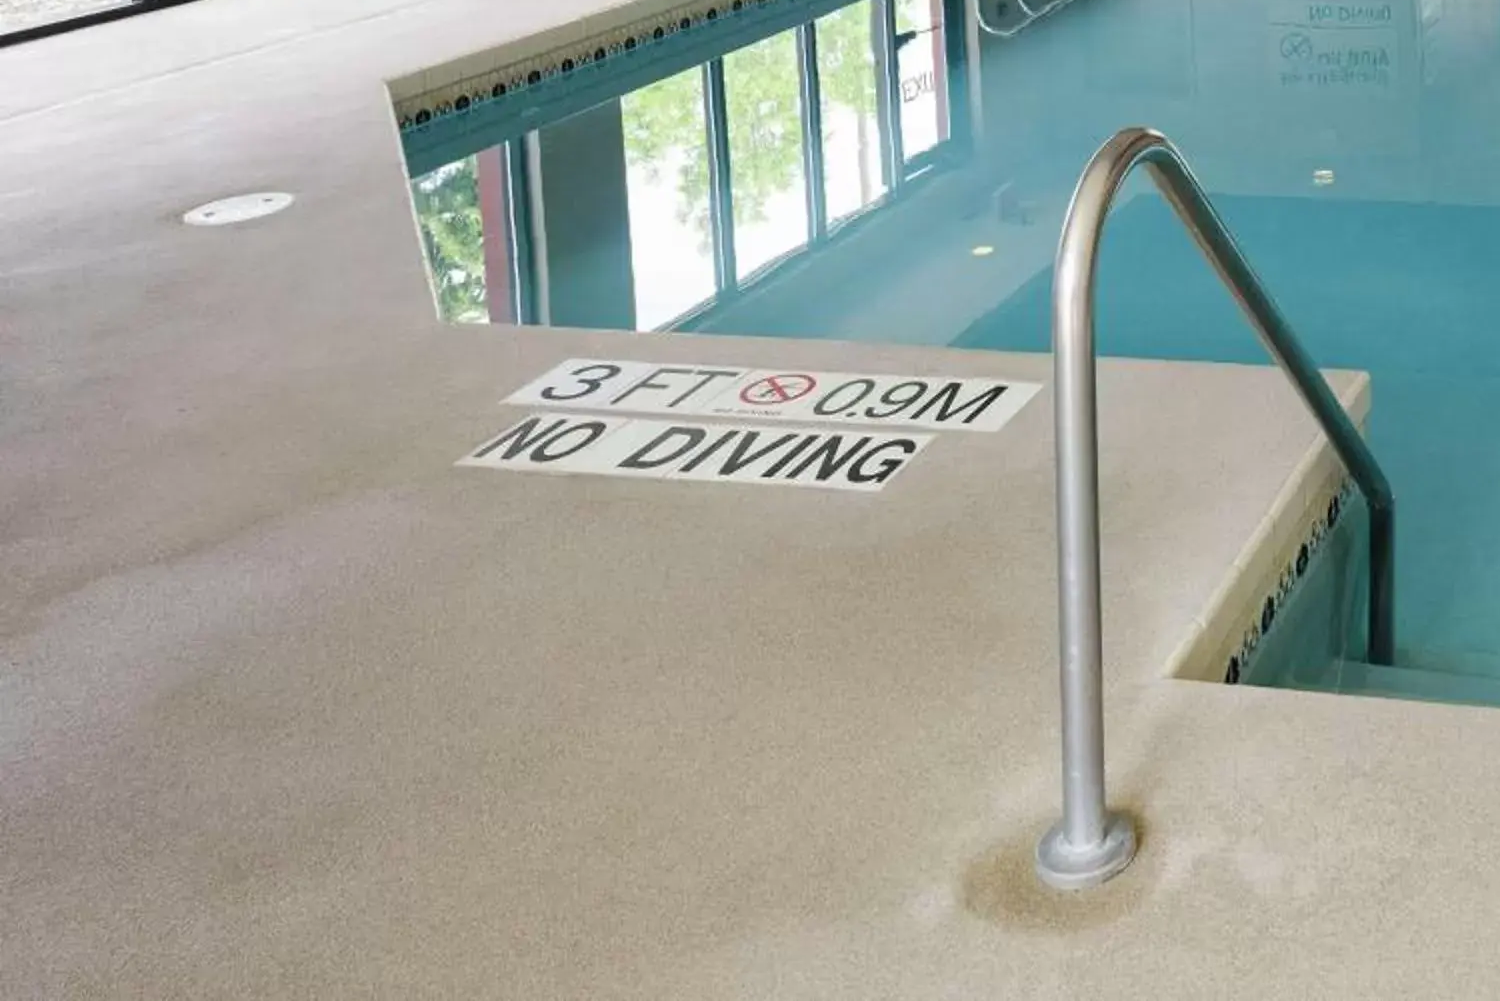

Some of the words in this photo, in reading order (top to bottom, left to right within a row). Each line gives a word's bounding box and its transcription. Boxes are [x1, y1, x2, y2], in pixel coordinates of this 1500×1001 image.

[541, 364, 621, 400] 3
[610, 368, 739, 409] FT
[812, 378, 1009, 424] 0.9M
[472, 417, 607, 462] NO
[616, 425, 918, 485] DIVING
